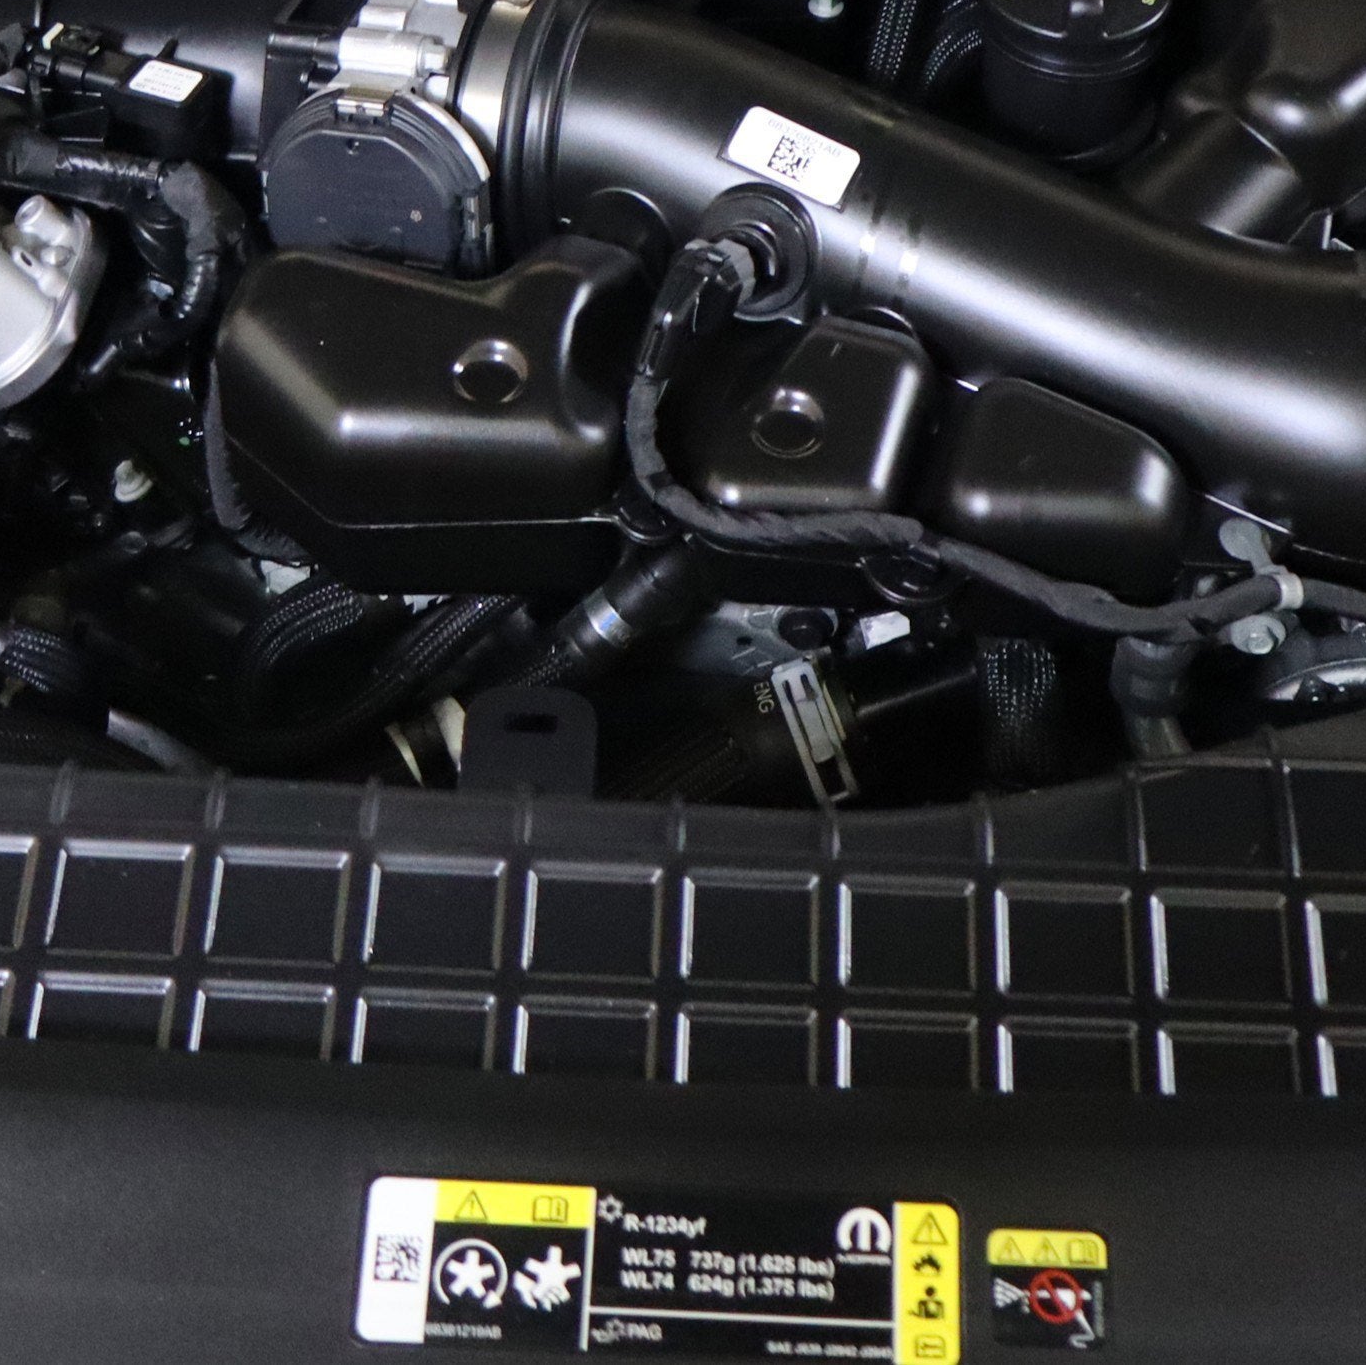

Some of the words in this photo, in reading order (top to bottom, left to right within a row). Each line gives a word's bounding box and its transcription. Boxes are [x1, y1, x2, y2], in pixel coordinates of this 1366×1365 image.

[753, 681, 775, 714] ENG
[622, 1212, 707, 1239] R-1234yf
[621, 1246, 676, 1269] WL75
[690, 1250, 735, 1275] 737g
[620, 1269, 675, 1291] WL74
[687, 1272, 735, 1298] 624g
[627, 1323, 663, 1341] PAG
